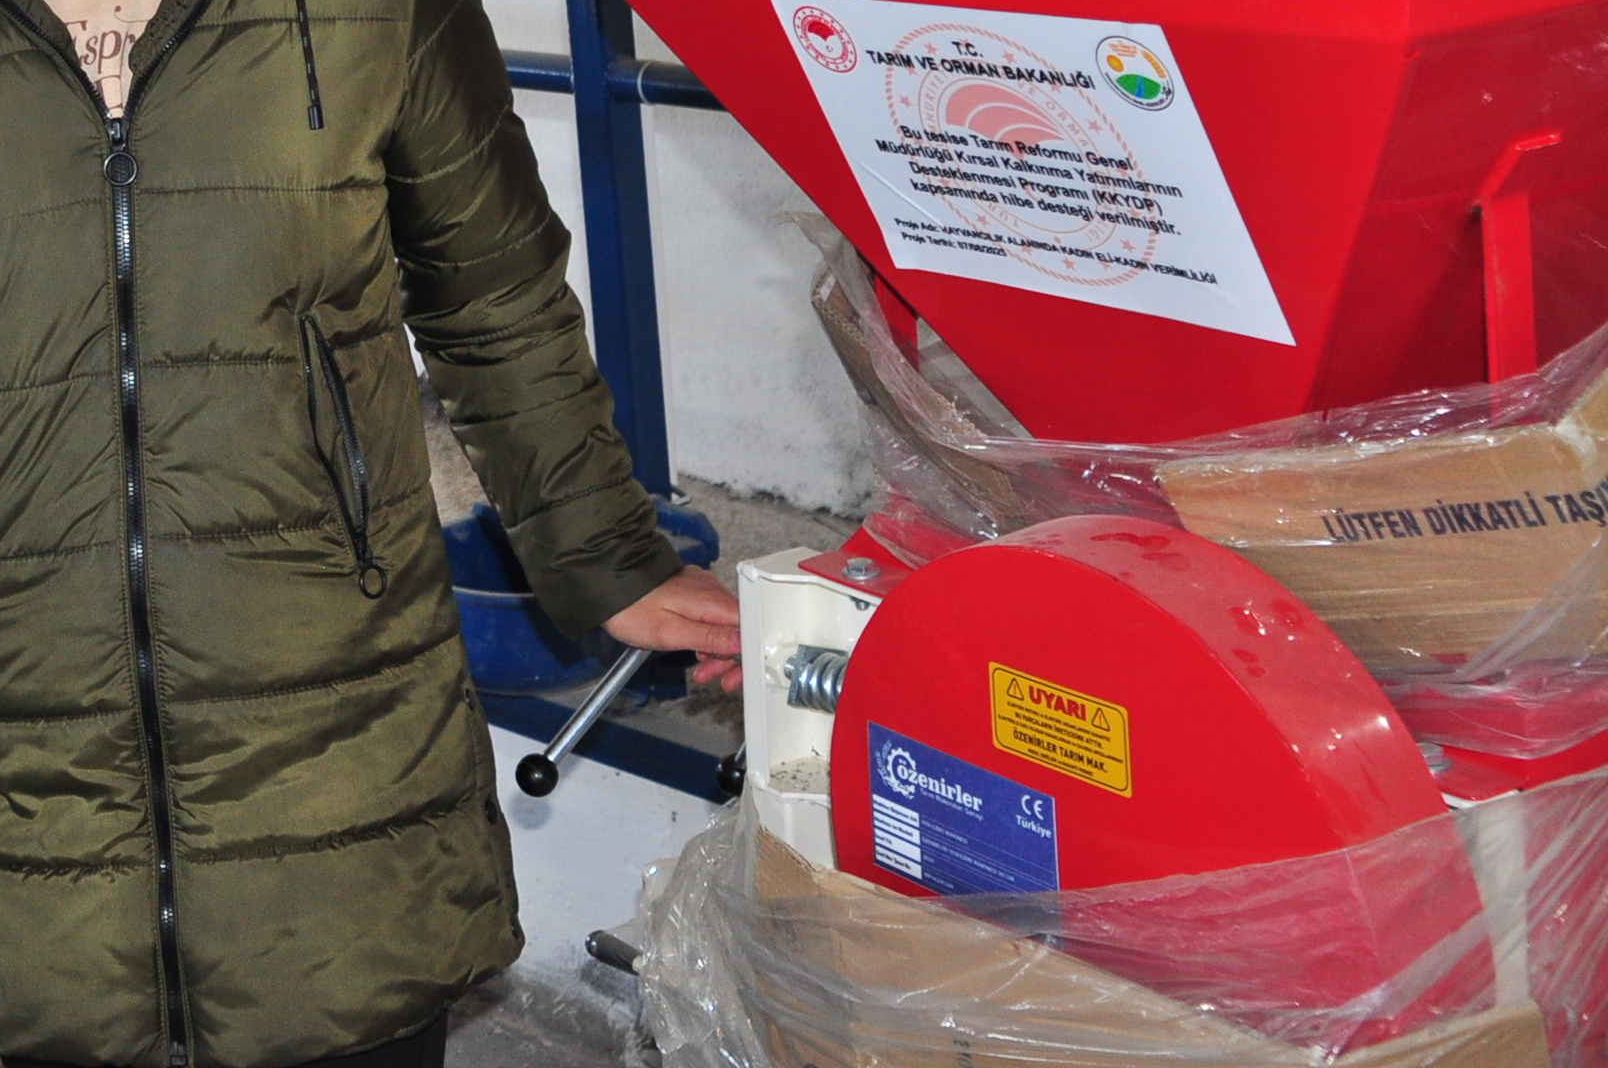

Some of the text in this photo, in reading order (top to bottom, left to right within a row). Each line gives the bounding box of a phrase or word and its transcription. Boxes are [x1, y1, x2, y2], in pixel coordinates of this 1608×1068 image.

[866, 50, 915, 69] TARIM
[915, 56, 940, 71] VE
[941, 59, 1000, 79] ORMAN
[1002, 65, 1096, 90] BAKANLIĞI
[951, 41, 984, 58] T.C.
[875, 139, 1183, 198] Müdürlüğü Kırsal Kalkınma Yatırımlarının
[900, 125, 1134, 171] Bu tesise Tarım Reformu Genel
[908, 161, 1017, 188] Desteklenmesi
[1017, 176, 1090, 200] Programı
[1091, 189, 1163, 216] (KKYDP)
[910, 178, 999, 203] kapsamında
[1000, 191, 1034, 210] hibe
[1037, 198, 1094, 222] desteği
[1095, 210, 1182, 235] verilmiştir.
[1321, 507, 1424, 543] LÜTFEN
[1421, 491, 1546, 536] DİKKATLİ
[1028, 685, 1087, 722] UYARI
[1013, 726, 1058, 754] ÖZENİRLER
[1059, 745, 1085, 765] TARIM
[1086, 755, 1108, 773] MAK.
[1015, 814, 1052, 838] Türkiye
